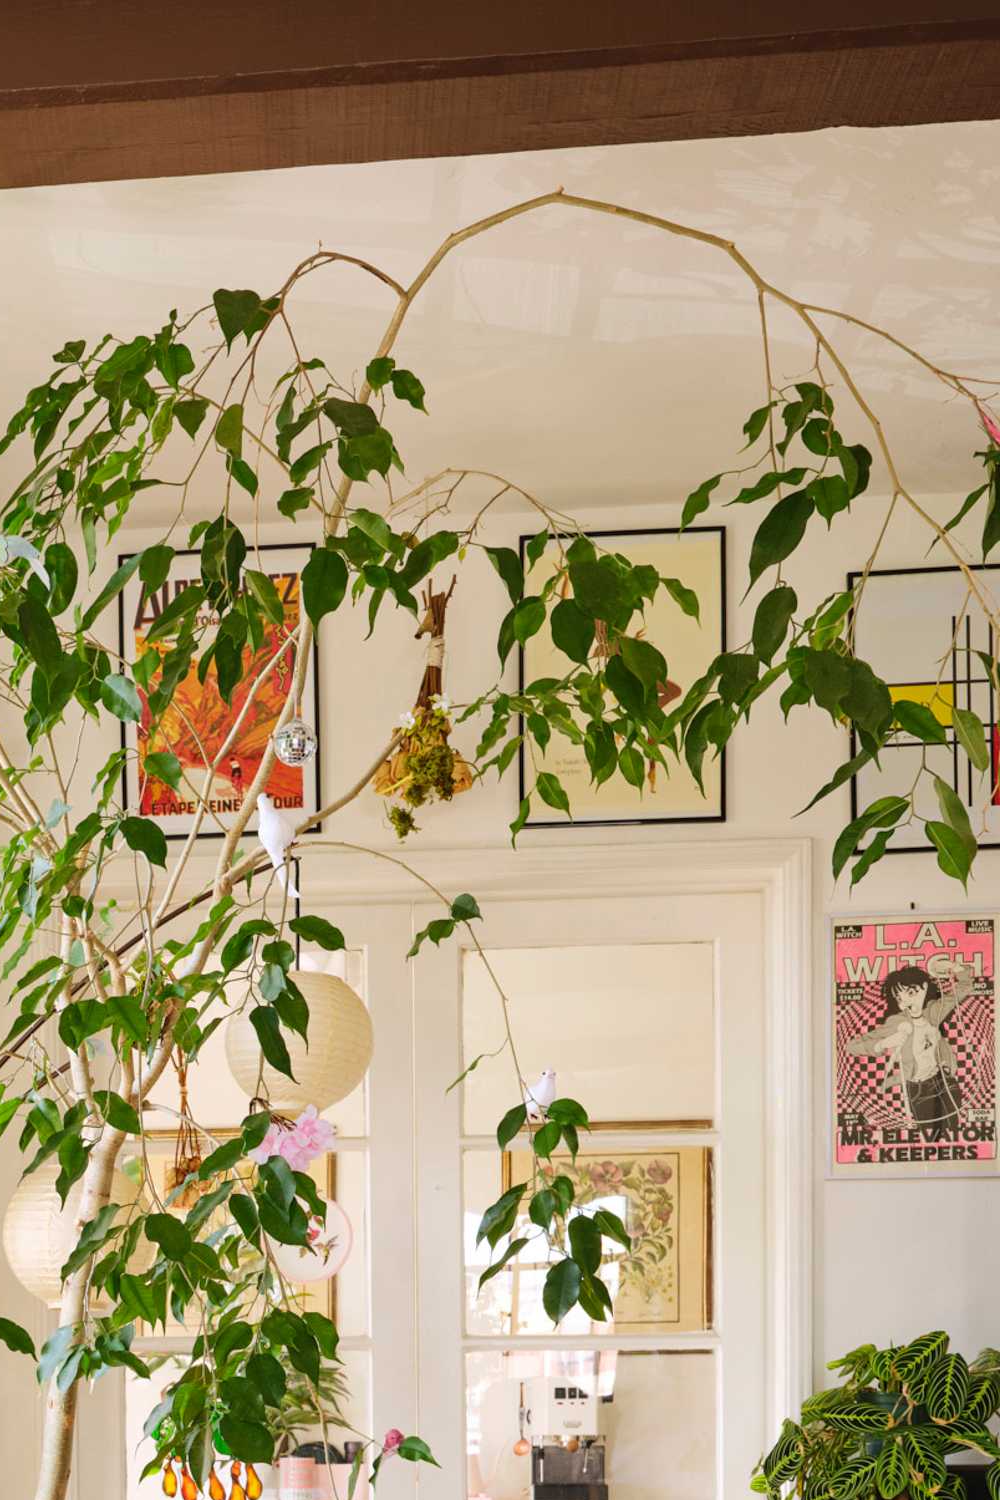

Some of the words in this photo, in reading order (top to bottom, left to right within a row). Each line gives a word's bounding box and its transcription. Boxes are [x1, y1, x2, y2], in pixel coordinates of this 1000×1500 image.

[273, 796, 303, 809] OUR
[875, 922, 958, 950] L.A.
[882, 1126, 994, 1144] ELEVATOR
[857, 1149, 873, 1162] &
[880, 1145, 978, 1162] KEEPERS
